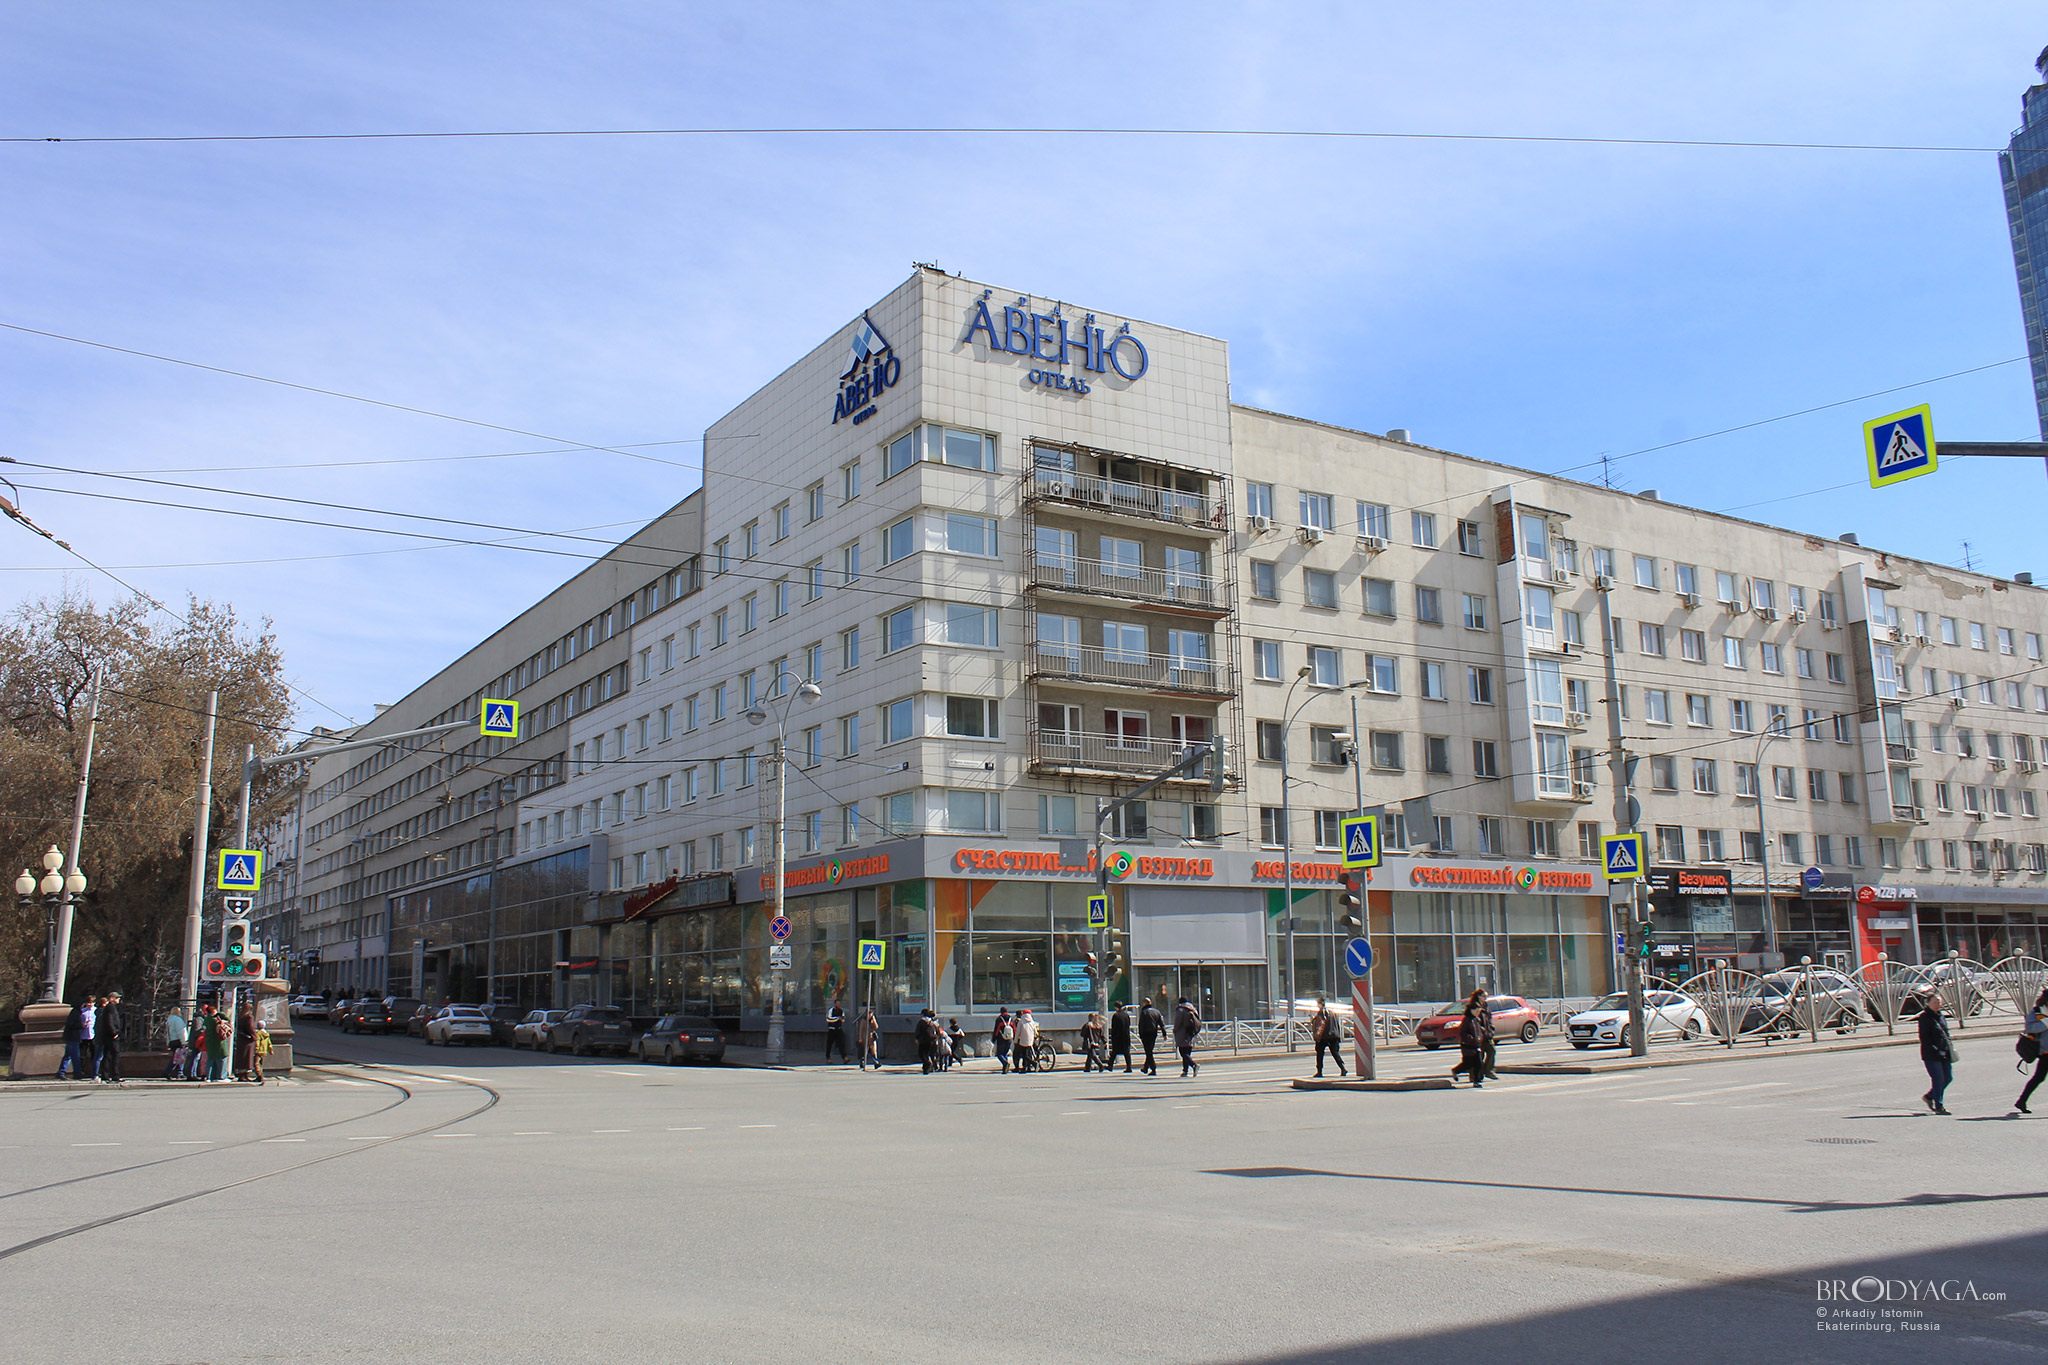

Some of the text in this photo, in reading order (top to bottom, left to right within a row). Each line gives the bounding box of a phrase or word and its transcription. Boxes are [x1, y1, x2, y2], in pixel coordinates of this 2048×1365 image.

[984, 289, 1130, 334] ГРАНД
[963, 300, 1149, 380] АВЕНЮ
[832, 356, 900, 424] АВЕНЮ
[1029, 368, 1091, 394] ОТЕЛЬ
[1679, 871, 1728, 887] Безумно.
[1874, 886, 1896, 898] IZZA
[230, 945, 242, 955] 42
